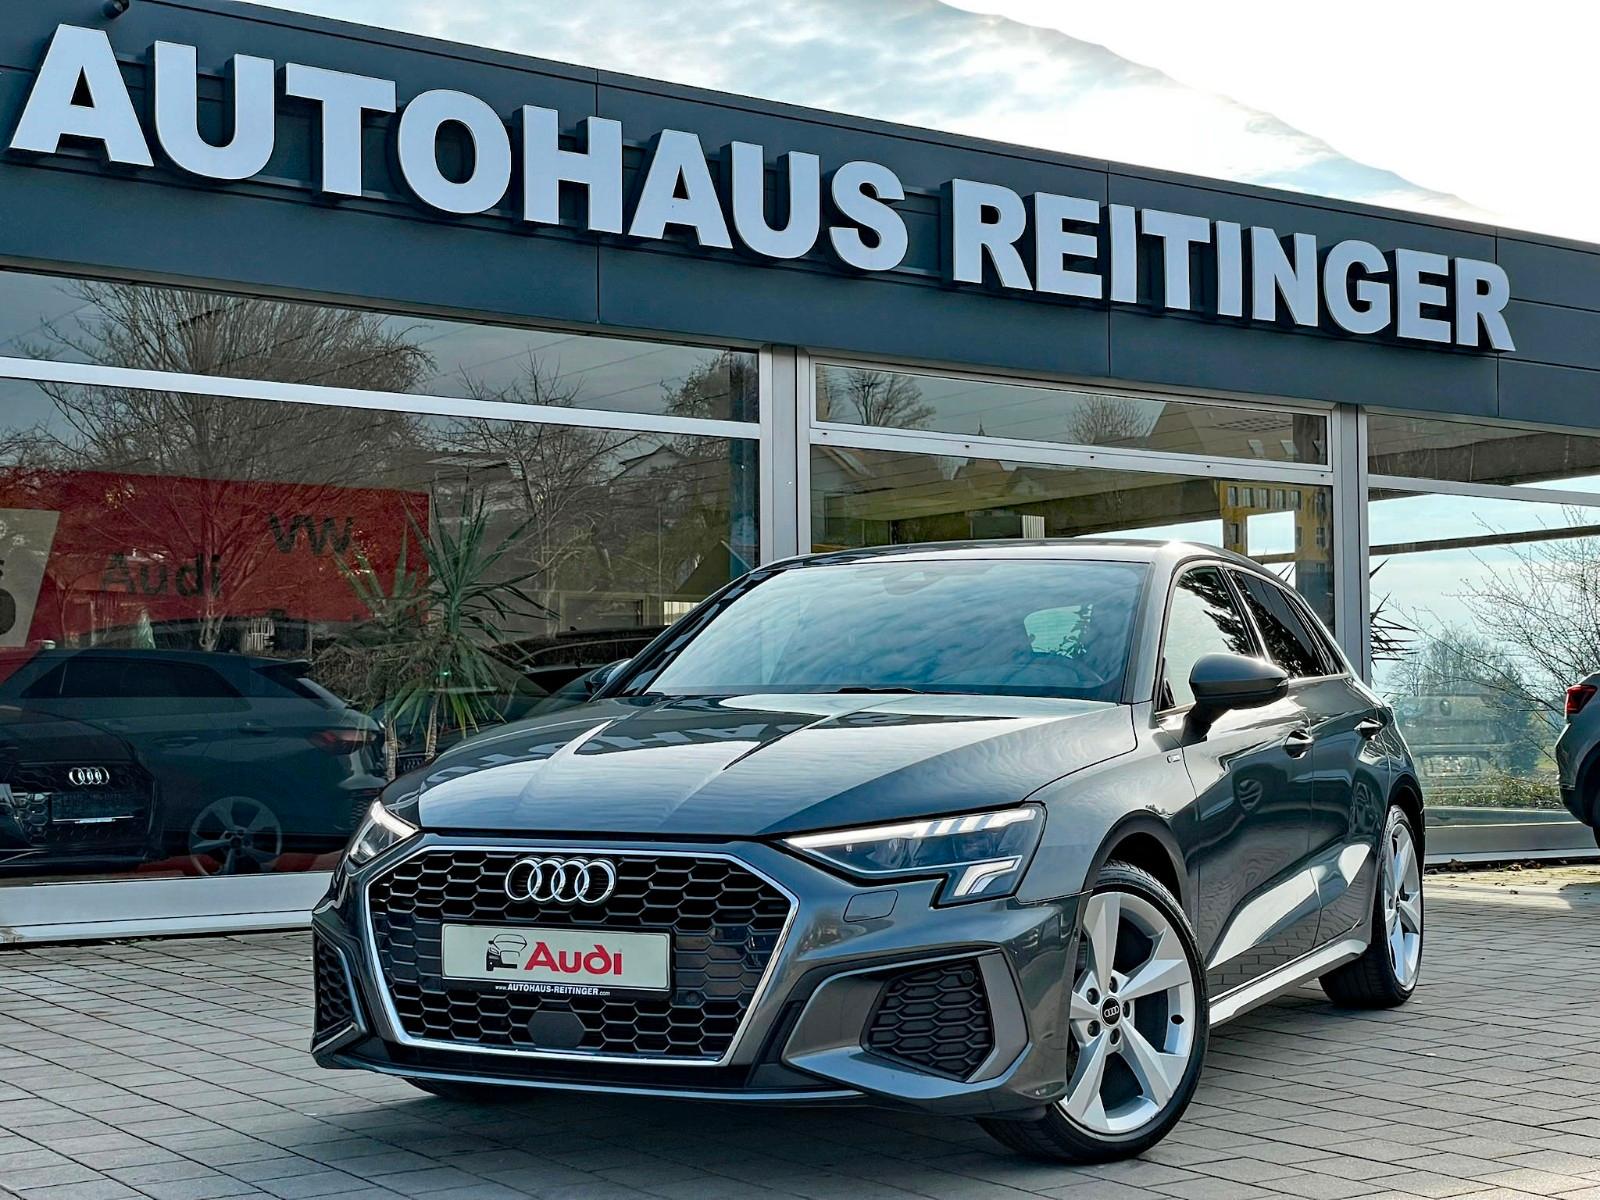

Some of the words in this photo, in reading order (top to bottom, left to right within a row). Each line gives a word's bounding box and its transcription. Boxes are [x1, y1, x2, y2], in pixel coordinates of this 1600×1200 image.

[9, 24, 909, 272] AUTOHAUS
[951, 178, 1516, 352] REITINGER
[102, 552, 222, 598] Audi
[523, 941, 622, 975] Audi
